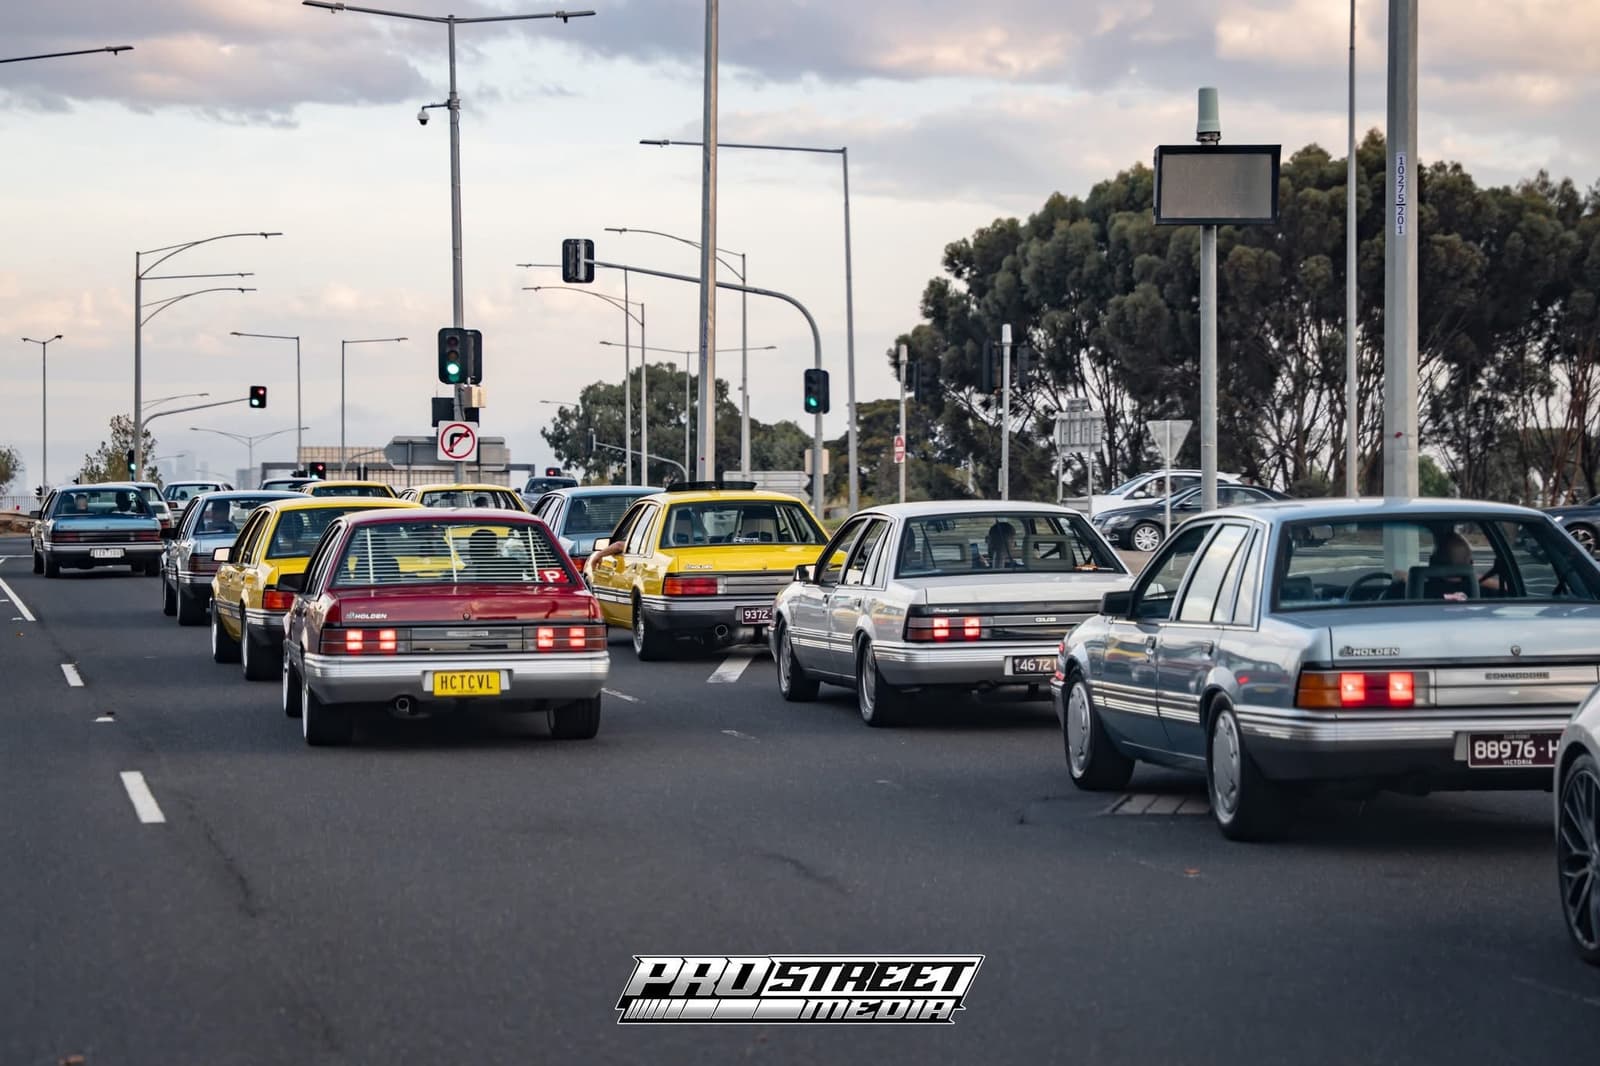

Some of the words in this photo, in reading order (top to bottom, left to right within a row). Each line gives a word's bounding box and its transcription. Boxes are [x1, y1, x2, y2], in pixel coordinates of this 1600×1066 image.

[543, 570, 561, 583] P
[1352, 647, 1400, 657] HOLDEN
[440, 674, 493, 690] HCTCVL
[1484, 672, 1550, 681] COMMODORE
